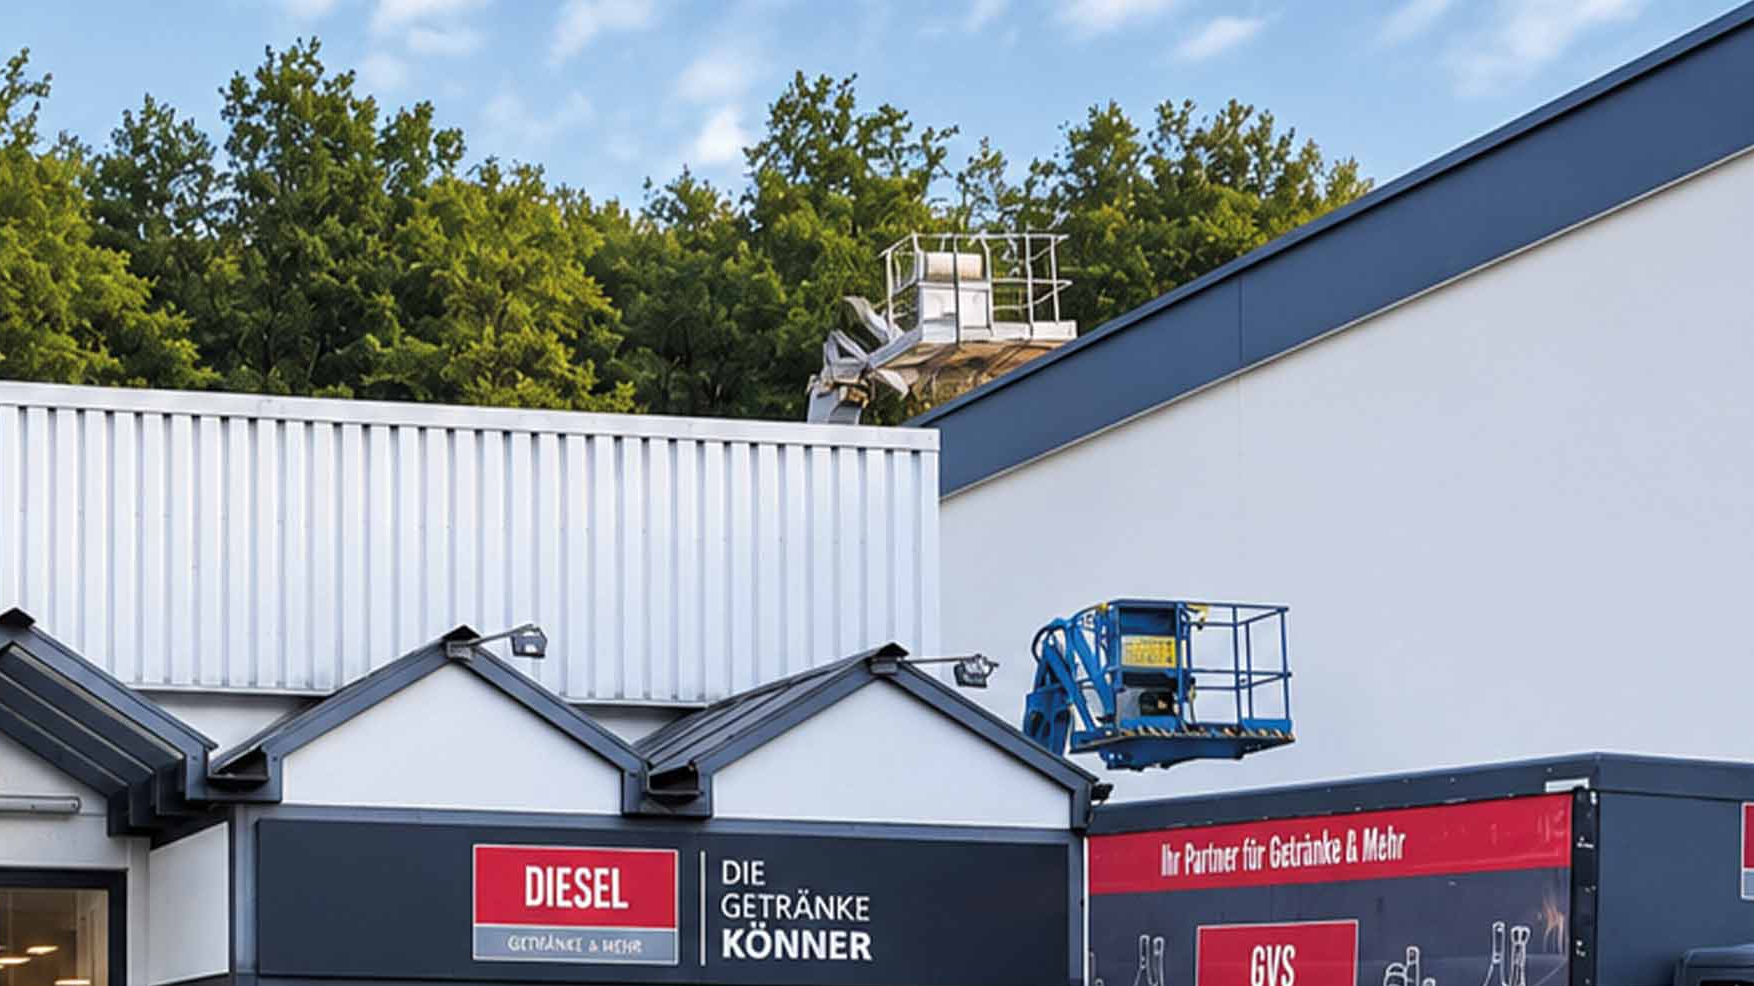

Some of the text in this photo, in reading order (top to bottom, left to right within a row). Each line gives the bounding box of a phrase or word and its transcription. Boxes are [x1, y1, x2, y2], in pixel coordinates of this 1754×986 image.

[1161, 825, 1406, 876] Ihr Partner für Getränke & Mehr
[525, 865, 629, 909] DIESEL
[722, 860, 766, 885] DIE
[721, 890, 871, 921] GETRÄNKE
[722, 923, 873, 960] KÖNNER
